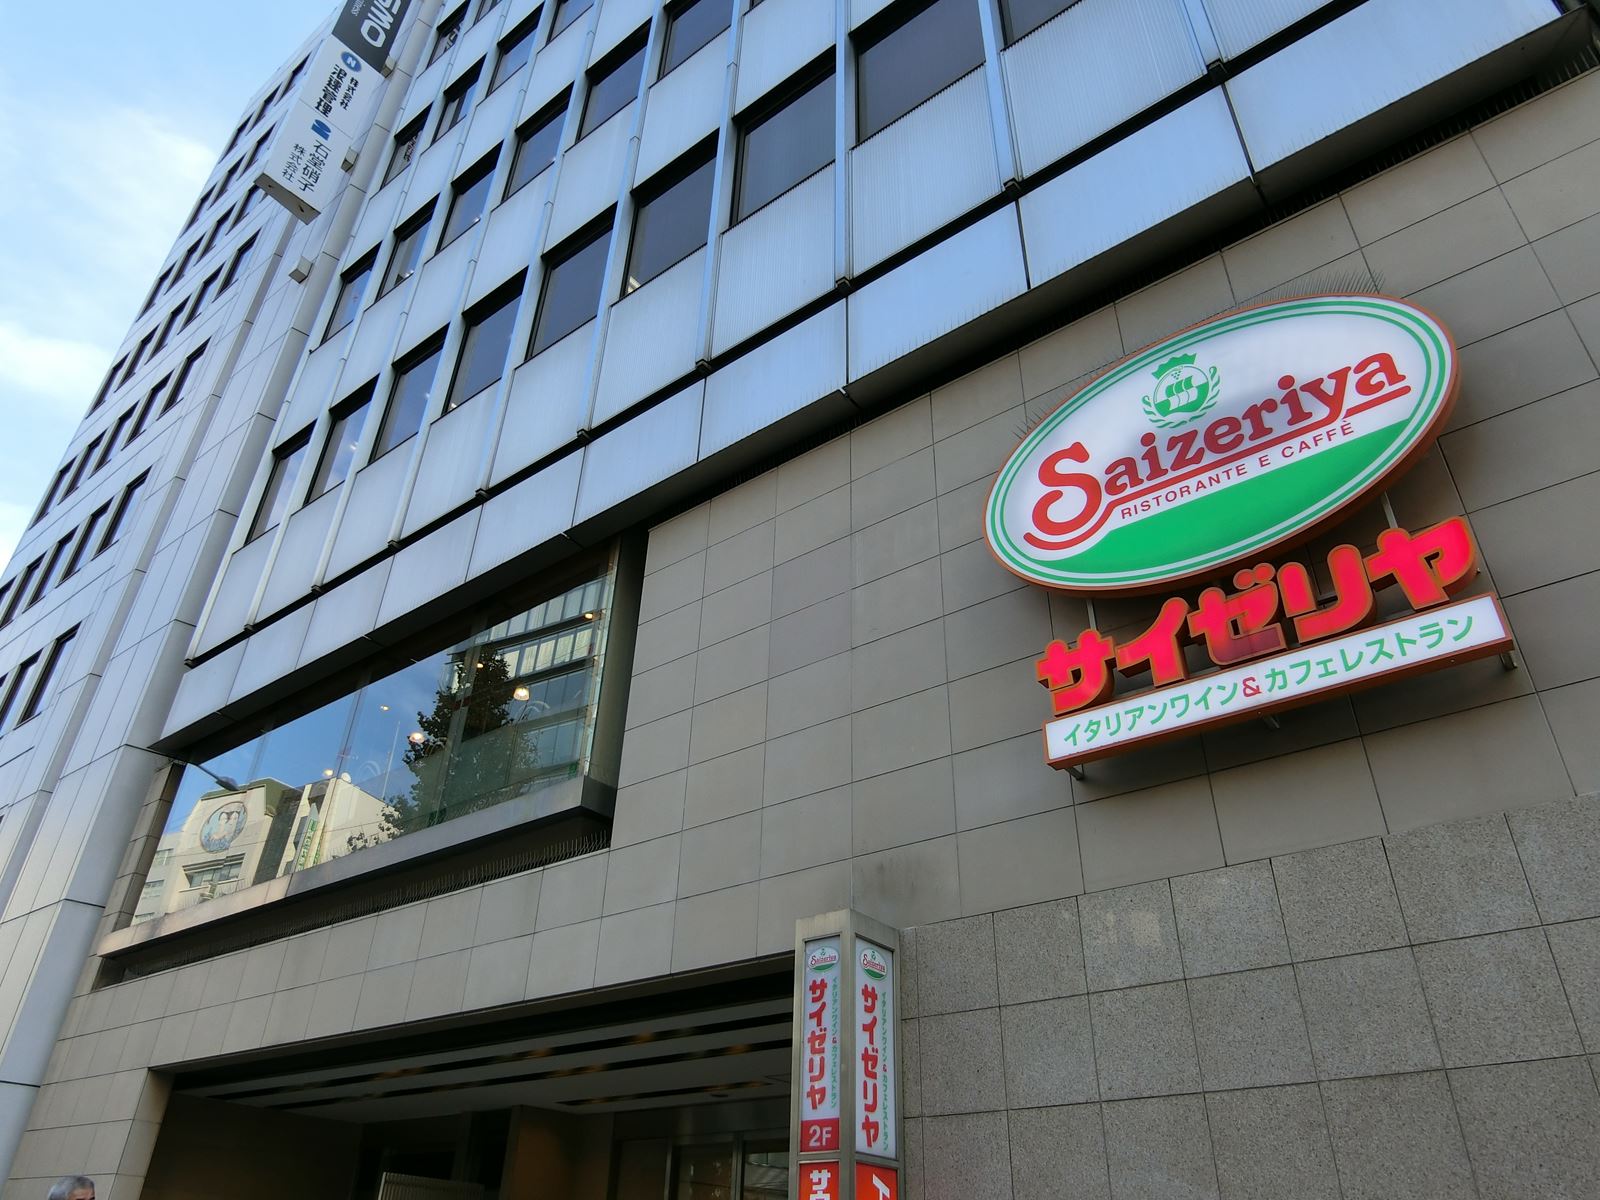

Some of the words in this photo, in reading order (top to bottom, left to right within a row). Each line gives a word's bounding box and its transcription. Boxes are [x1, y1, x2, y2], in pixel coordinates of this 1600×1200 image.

[340, 77, 359, 111] 株式会社
[282, 143, 305, 183] 株式会社
[298, 139, 332, 193] 石堂硝子
[1027, 351, 1409, 546] Saizeriya
[1120, 464, 1248, 520] RISTORANTE
[1258, 453, 1272, 468] E
[1281, 421, 1355, 459] CAFFÈ
[1036, 515, 1478, 717] サイゼリヤ
[1063, 615, 1474, 747] イタリアンワイン&カフェレストラン
[807, 978, 828, 1110] サイゼリヤ
[861, 983, 880, 1148] サイゼリヤ
[808, 1124, 832, 1148] 2F
